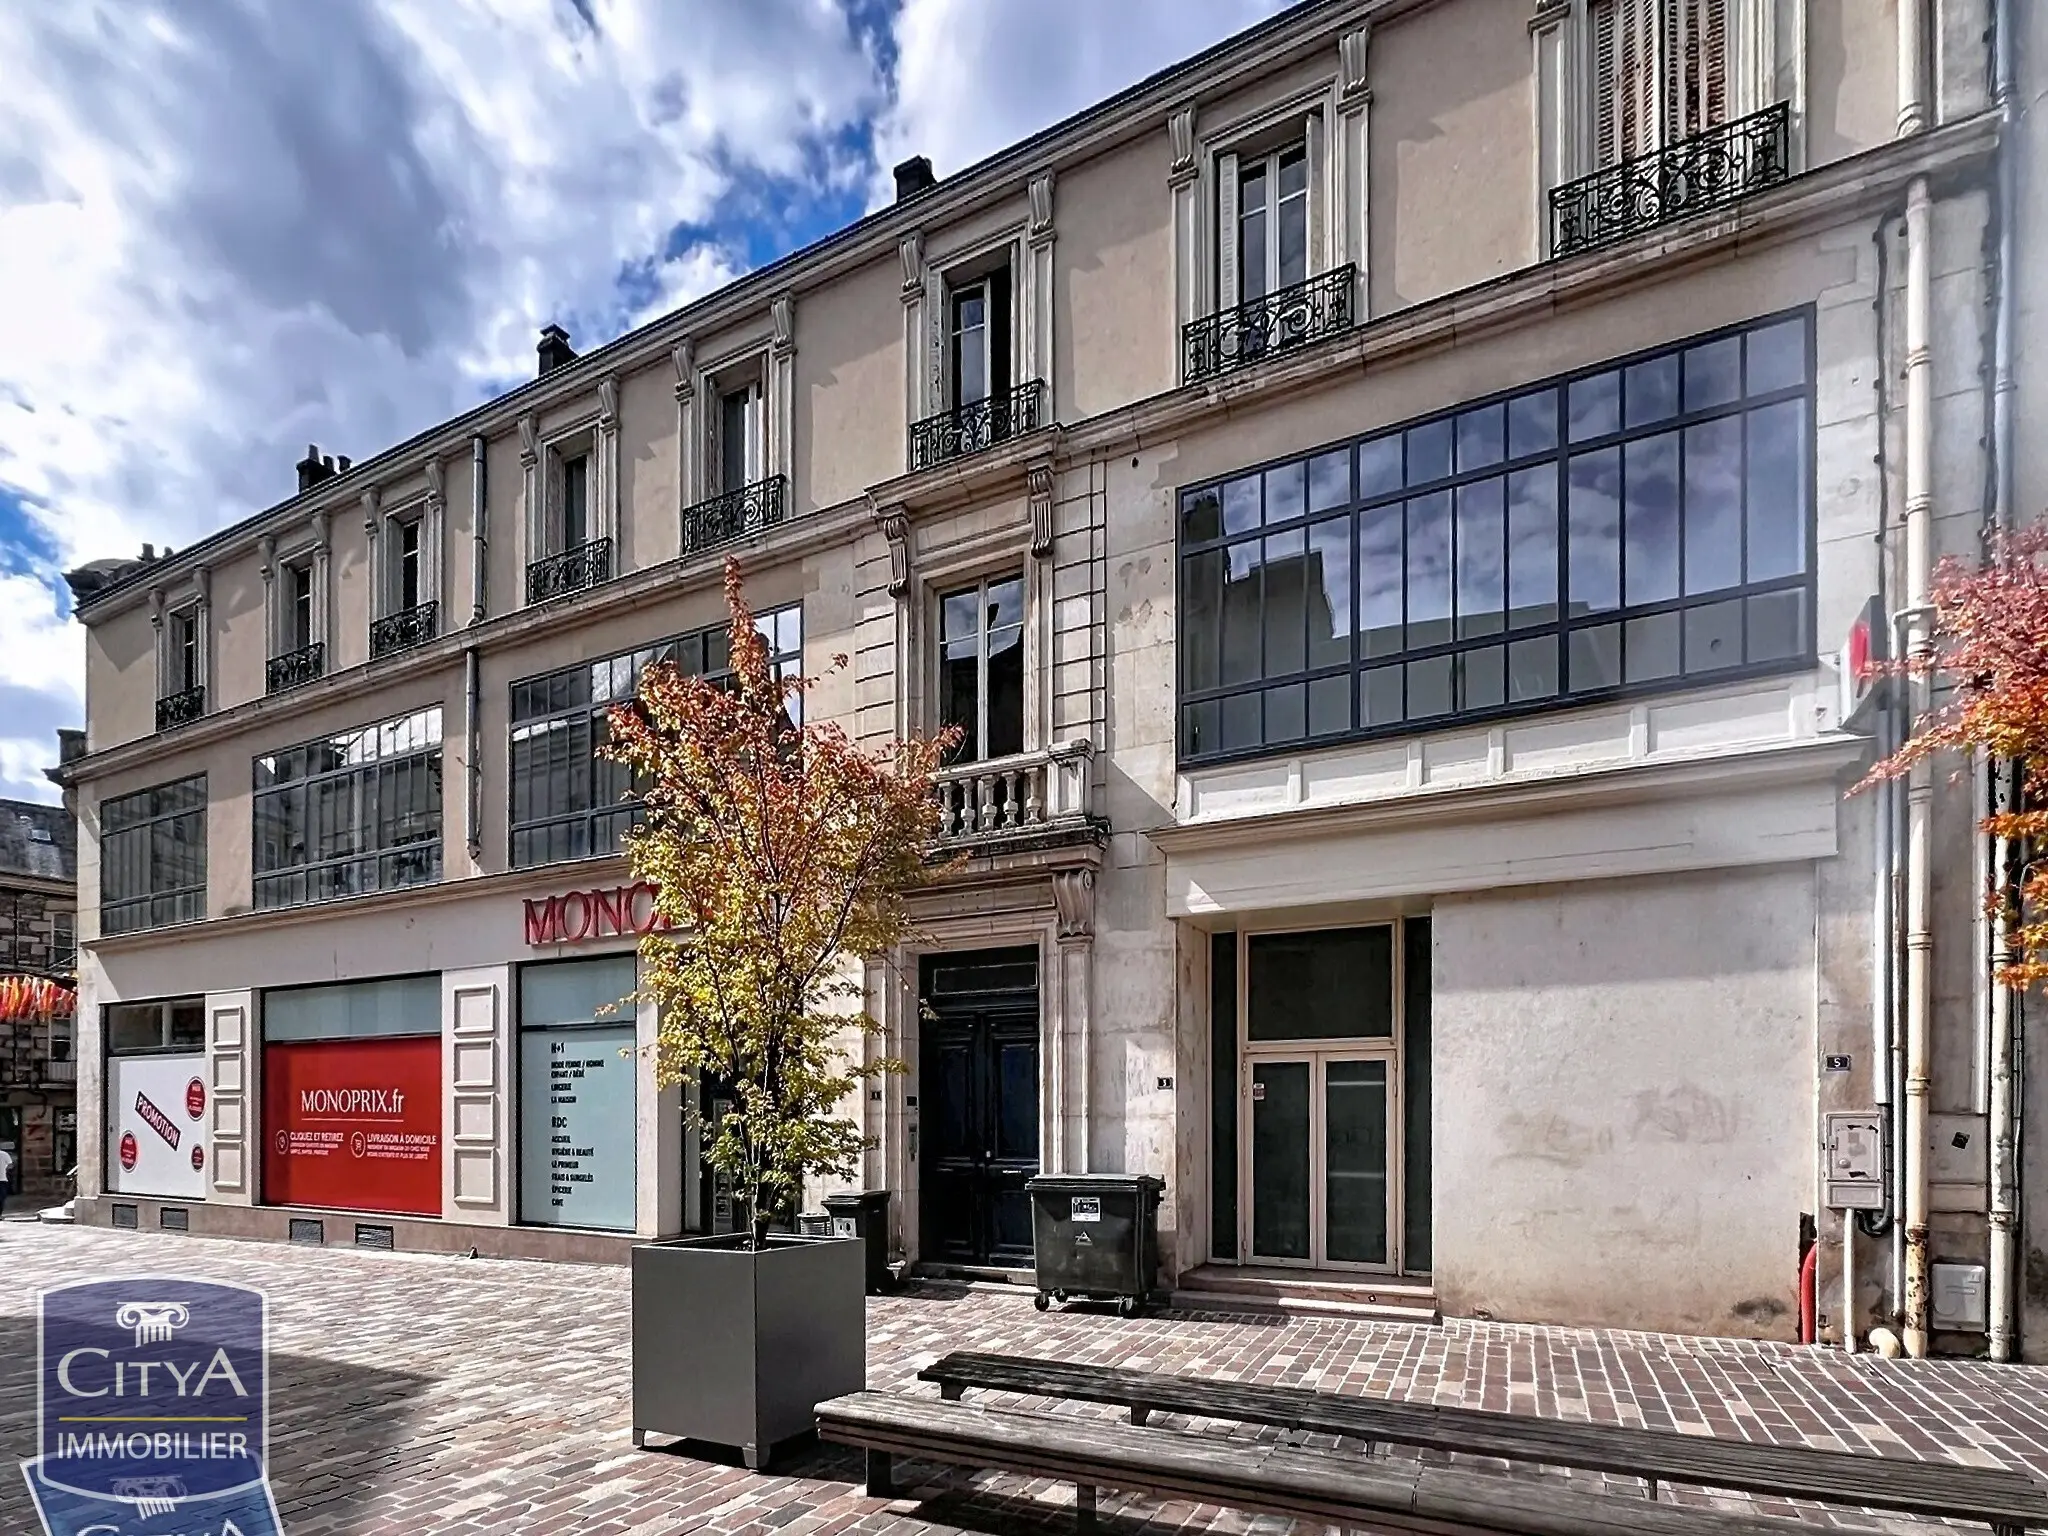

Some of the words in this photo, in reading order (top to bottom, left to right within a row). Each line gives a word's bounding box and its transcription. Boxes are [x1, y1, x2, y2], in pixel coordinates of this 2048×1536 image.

[522, 881, 671, 945] MONO
[1834, 1057, 1841, 1067] 5
[301, 1088, 404, 1113] MONOPRIX.fr
[137, 1095, 179, 1146] PROMOTION
[551, 1116, 567, 1128] RDC
[367, 1133, 399, 1143] LIVRAISON
[405, 1134, 437, 1145] DOMICILE
